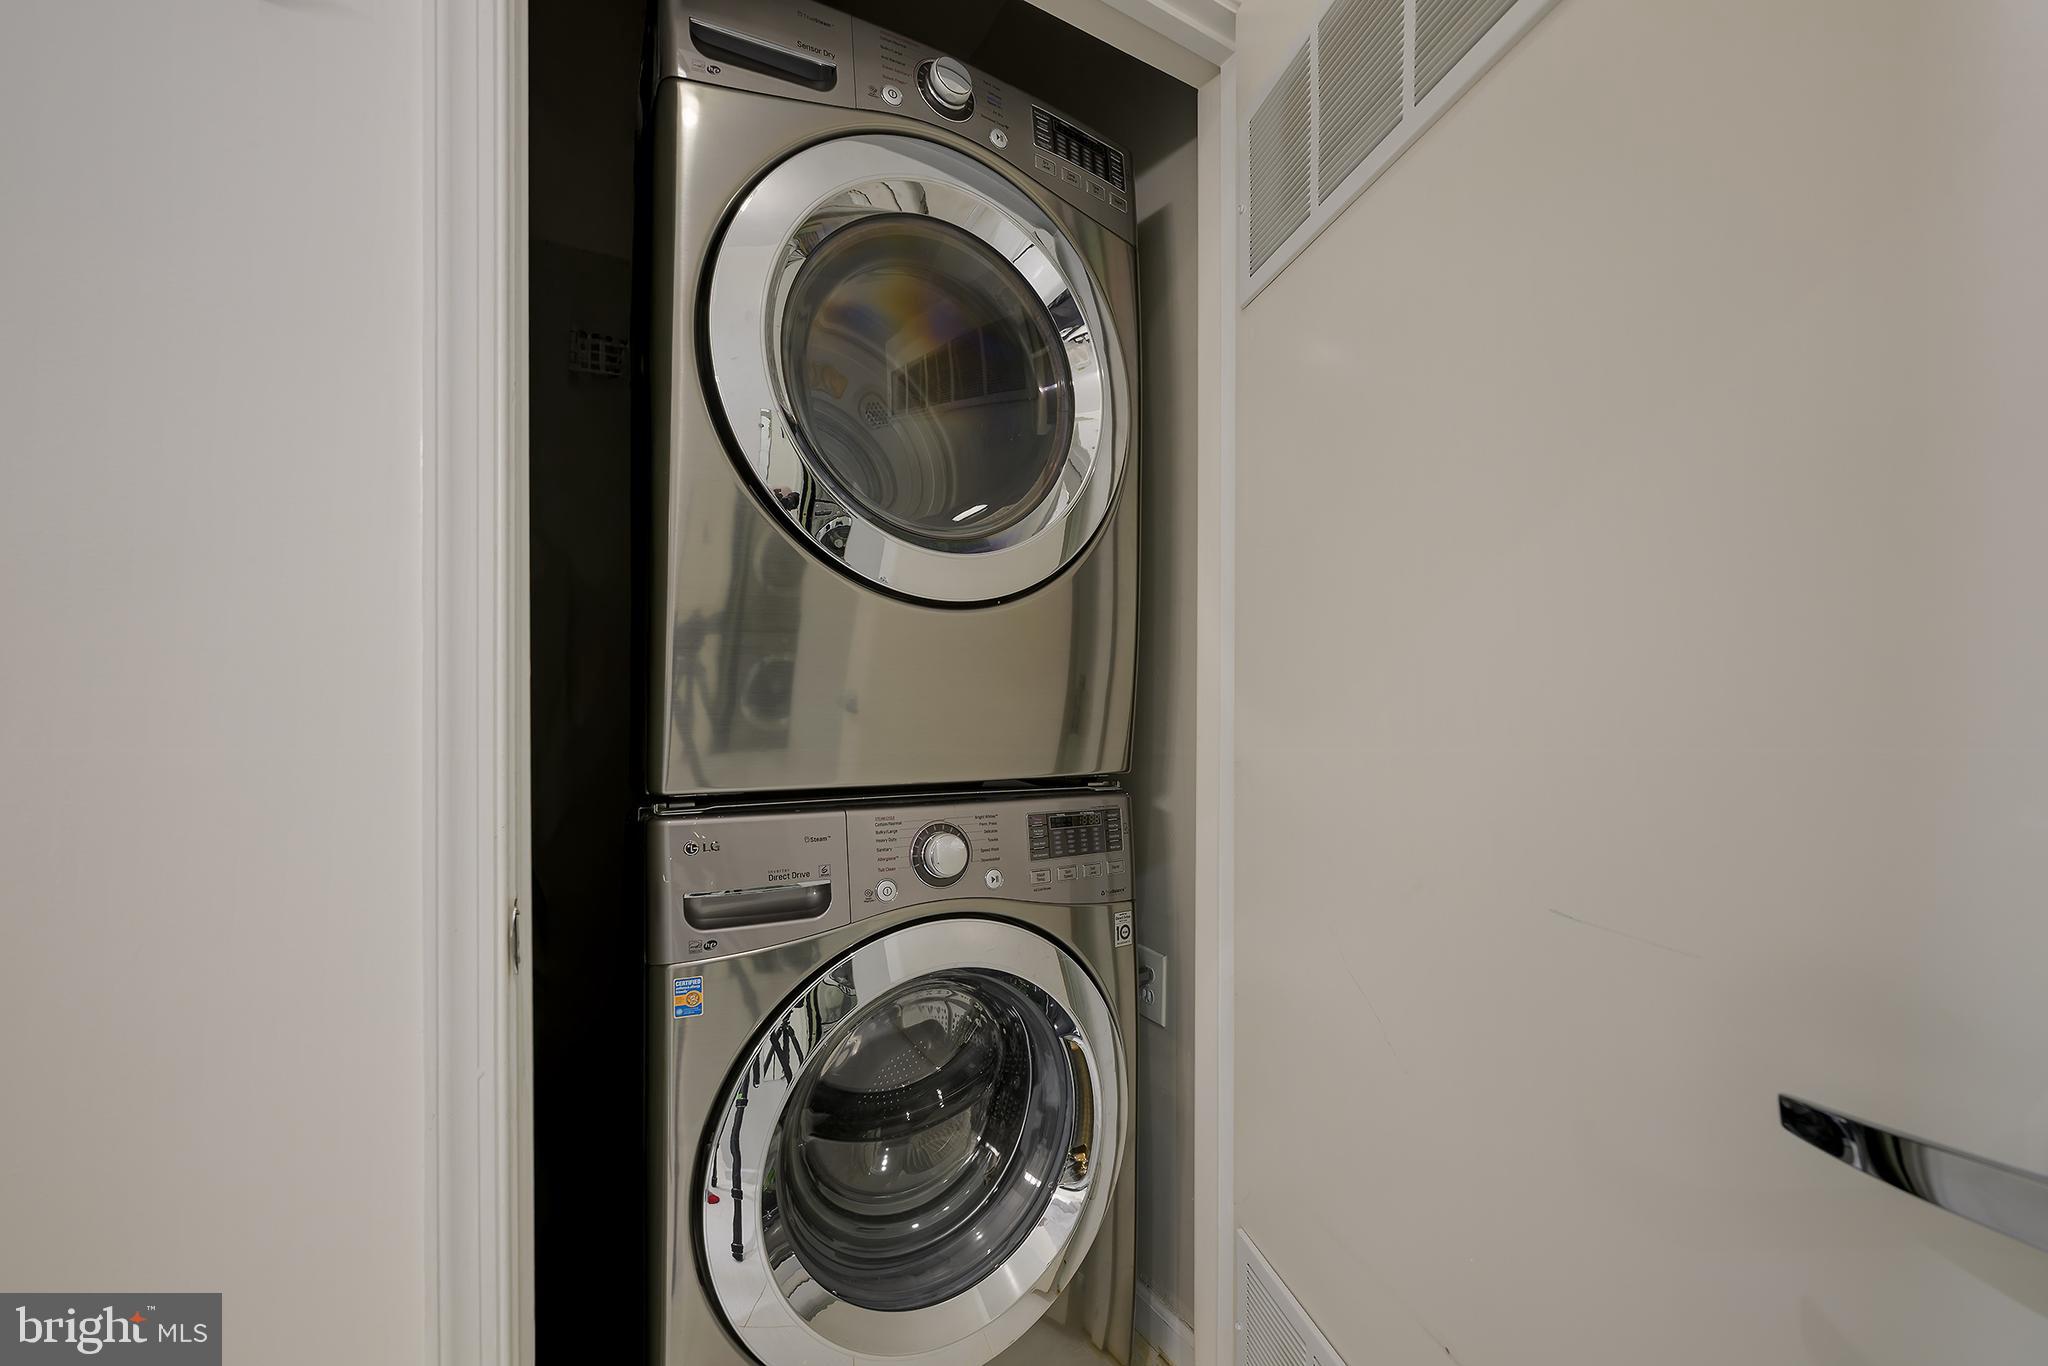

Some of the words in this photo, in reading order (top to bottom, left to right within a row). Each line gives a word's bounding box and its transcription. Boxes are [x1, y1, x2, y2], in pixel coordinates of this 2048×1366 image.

[797, 40, 822, 54] Sensor
[823, 49, 835, 60] Dry
[703, 841, 720, 852] LG
[768, 872, 790, 881] Direct
[791, 871, 811, 879] Drive
[1116, 923, 1131, 941] 10
[675, 979, 701, 987] CERTIFIED
